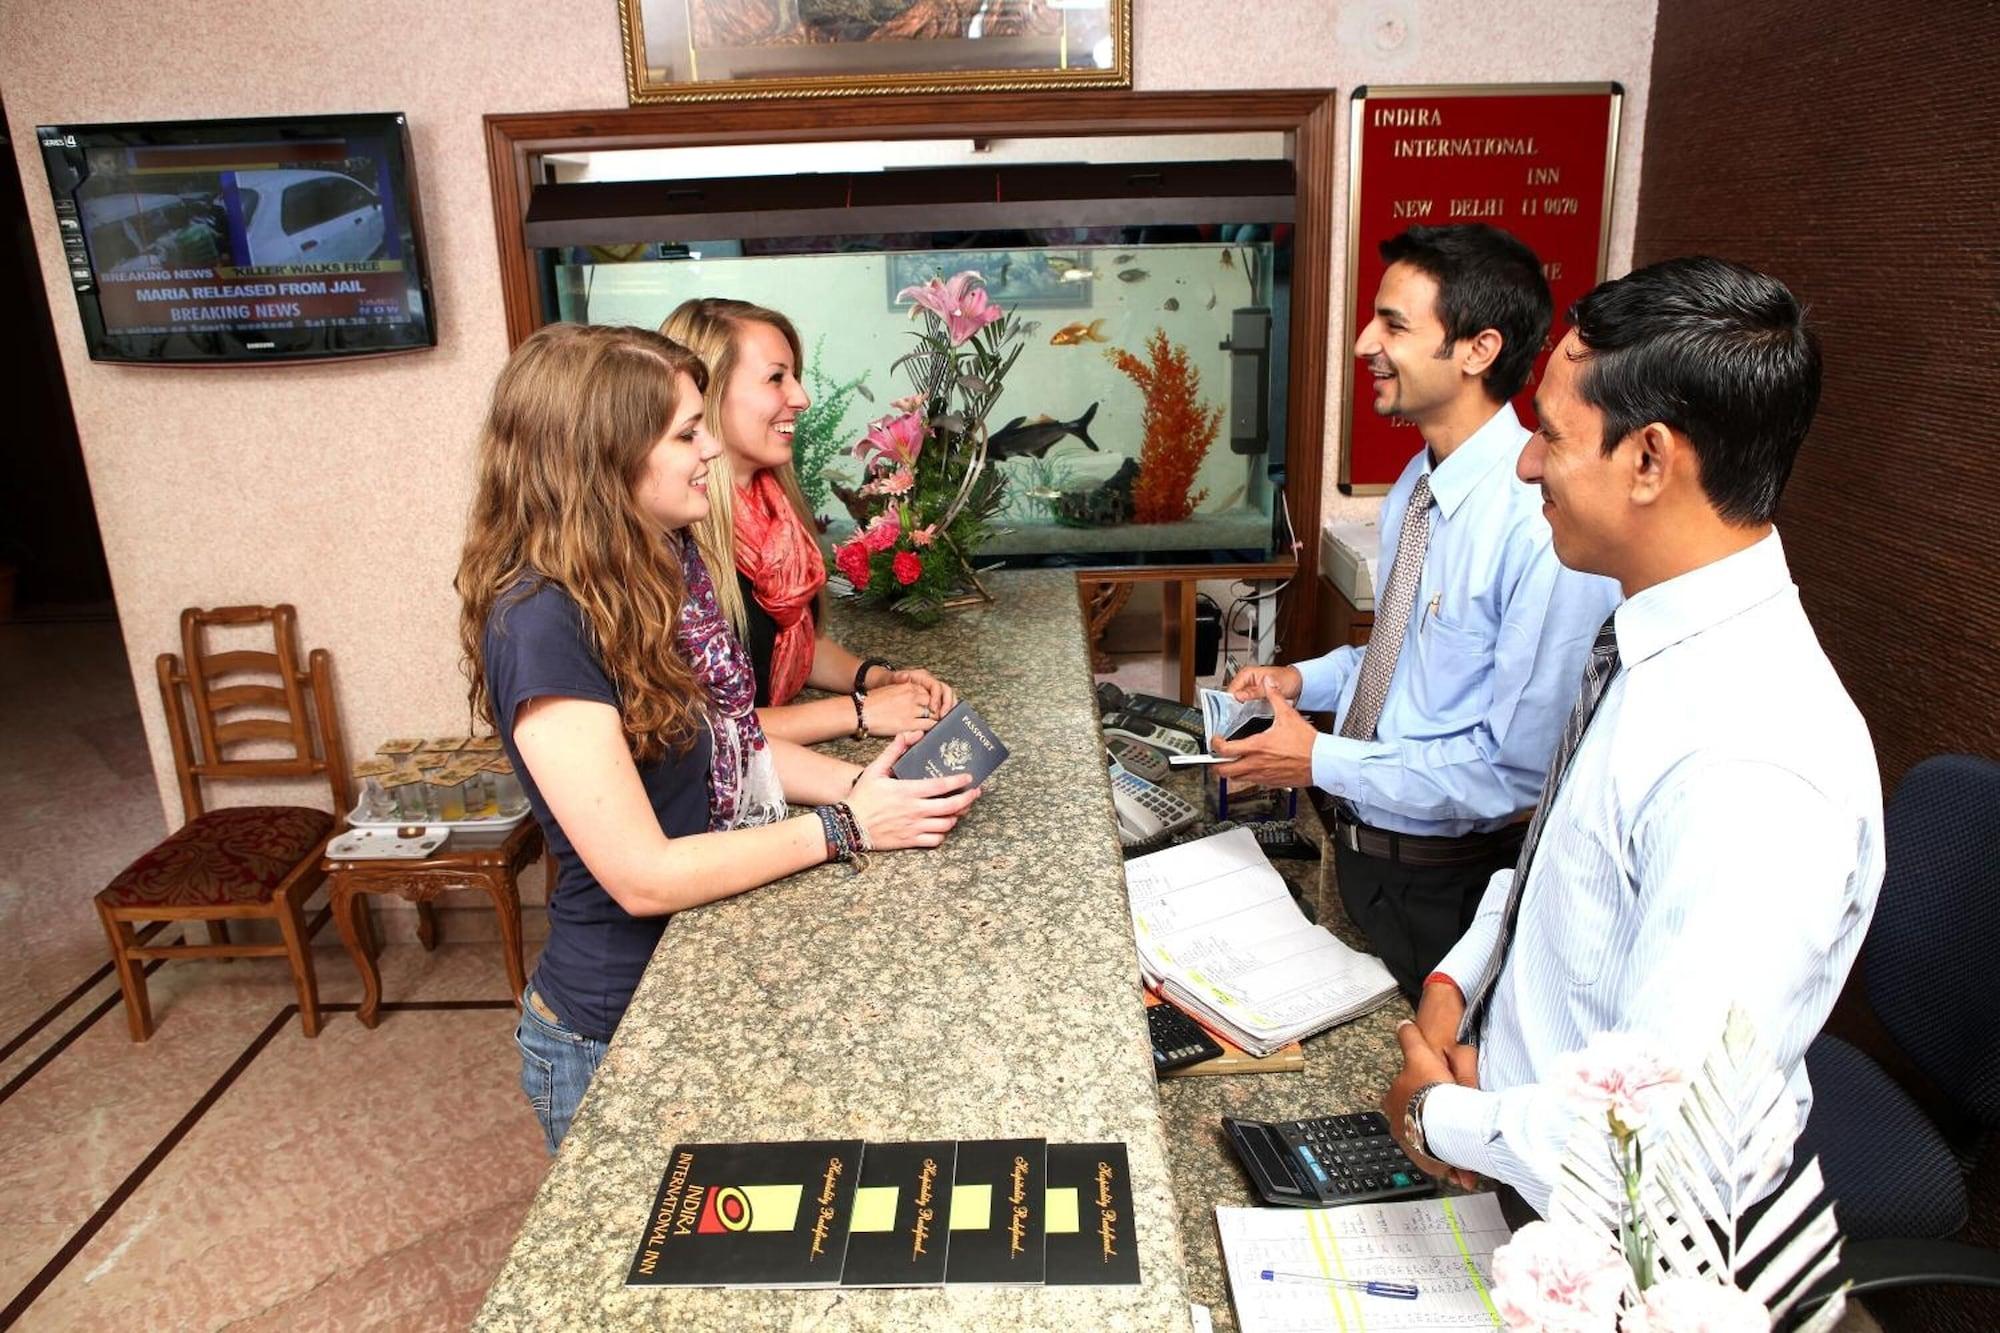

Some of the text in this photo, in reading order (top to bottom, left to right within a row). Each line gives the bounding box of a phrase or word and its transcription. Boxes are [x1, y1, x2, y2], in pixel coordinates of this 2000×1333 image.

[1374, 108, 1442, 127] INDIRA
[1394, 137, 1539, 158] INTERNATIONAL
[1527, 167, 1560, 185] INN
[1393, 200, 1433, 218] NEW
[1450, 199, 1504, 217] DELHI
[101, 267, 214, 283] BREAKING NEWS
[291, 263, 341, 273] WALKS
[344, 261, 380, 272] FREE
[136, 279, 366, 302] MARIA RELEASED FROM JAIL
[171, 302, 302, 322] BREAKING NEWS
[638, 1152, 694, 1275] INTERNATIONAL INN
[673, 1184, 705, 1235] INDIRA
